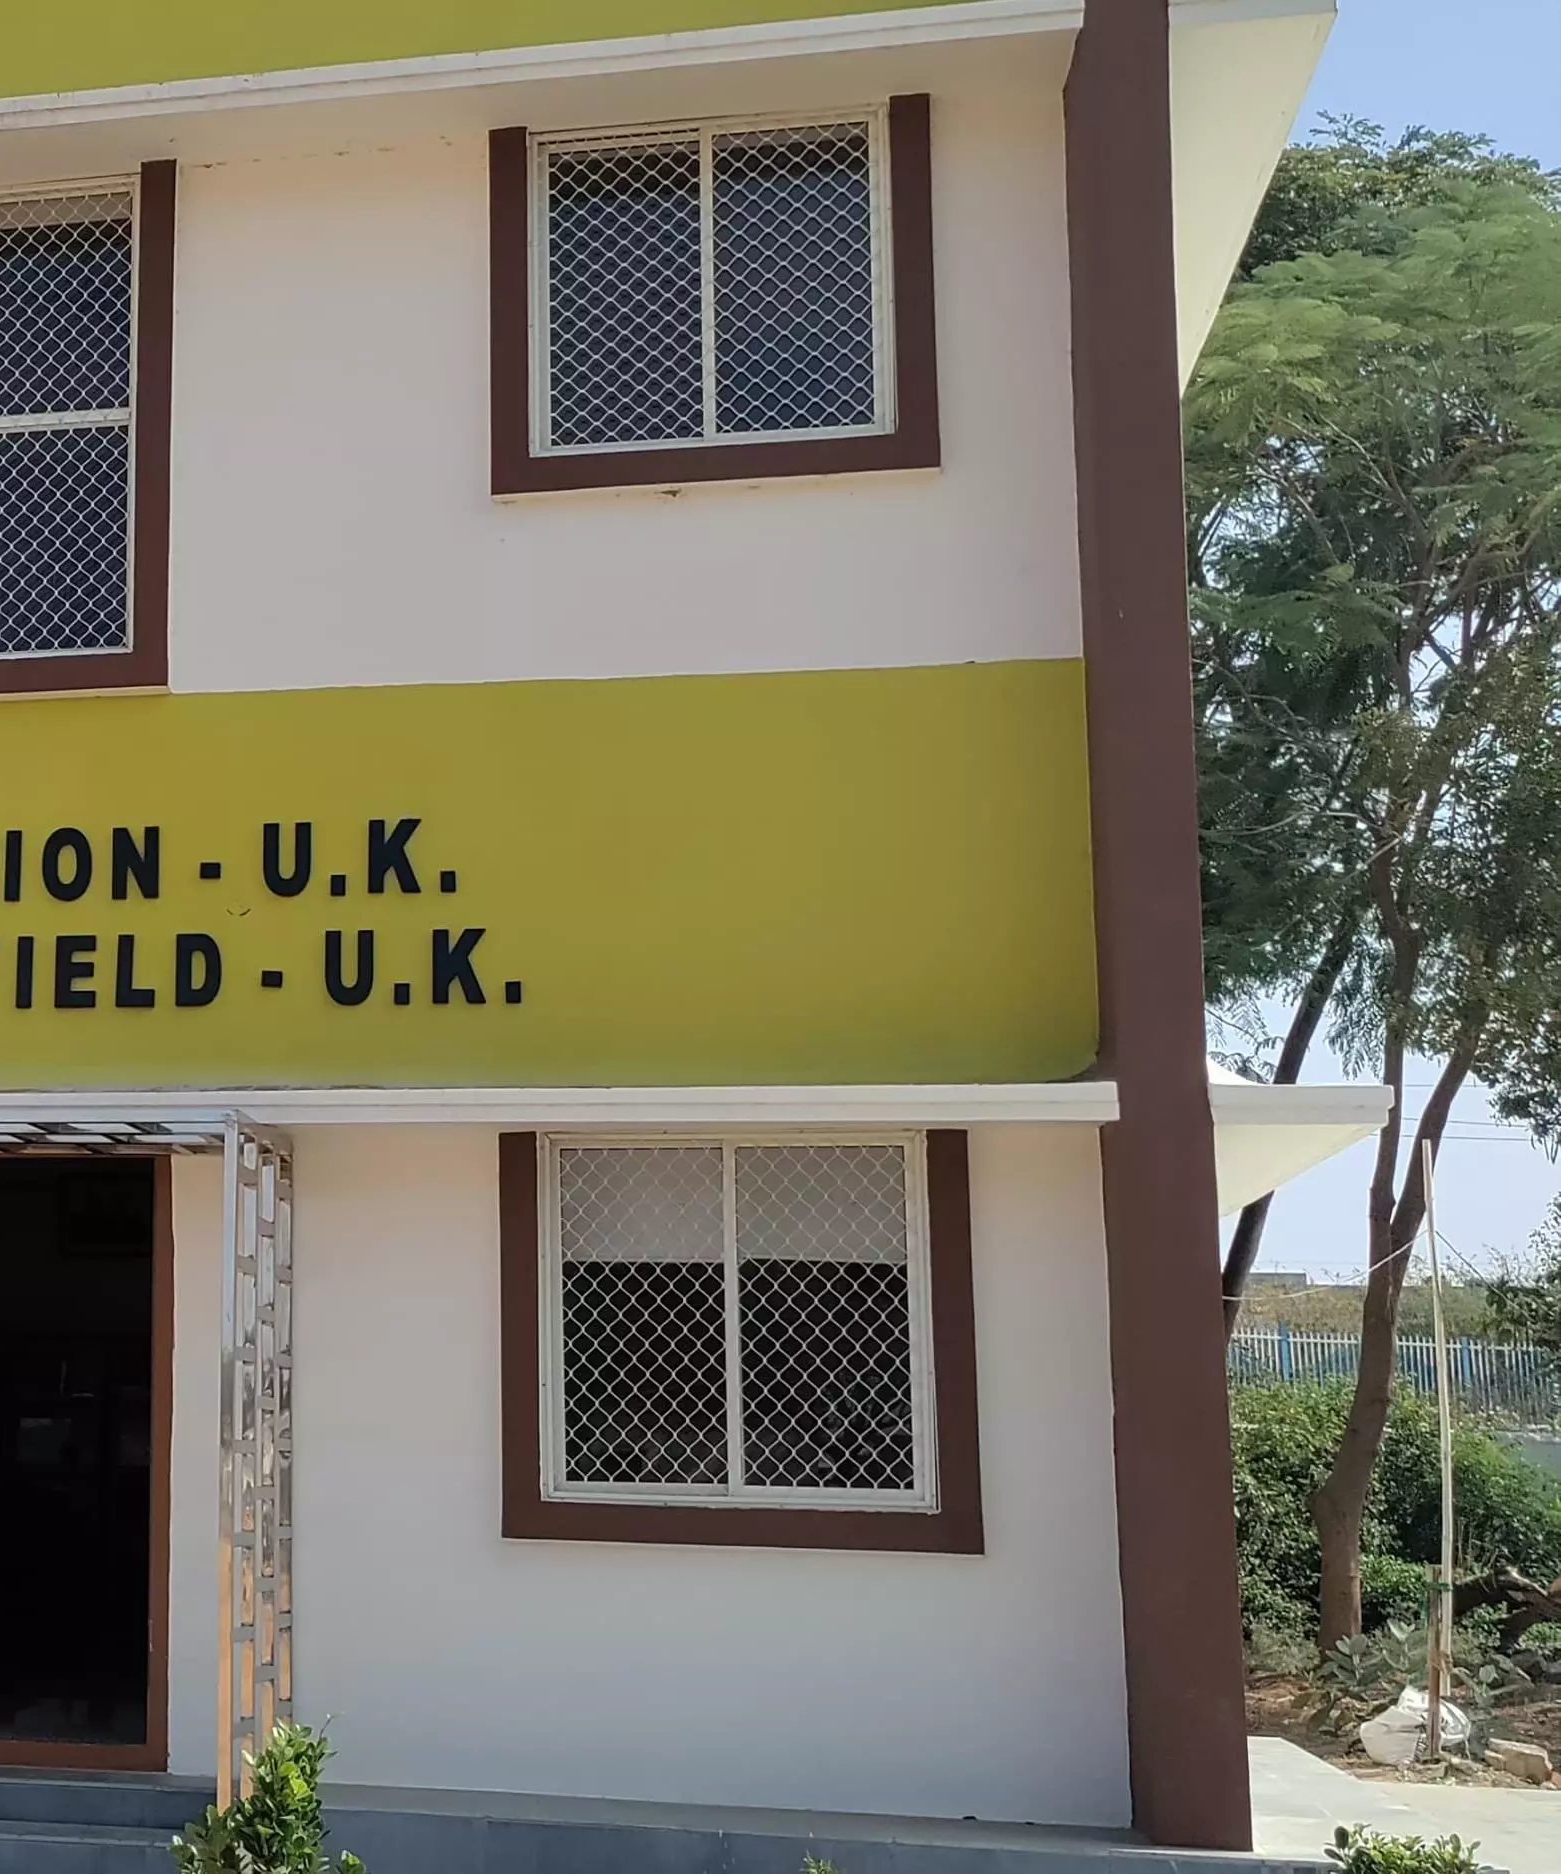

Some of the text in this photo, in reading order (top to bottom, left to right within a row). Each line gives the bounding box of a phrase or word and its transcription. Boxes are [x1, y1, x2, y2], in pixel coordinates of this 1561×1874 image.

[199, 862, 222, 880] -
[262, 818, 457, 898] U.K.
[260, 970, 284, 989] -
[324, 928, 522, 1007] U.K.
